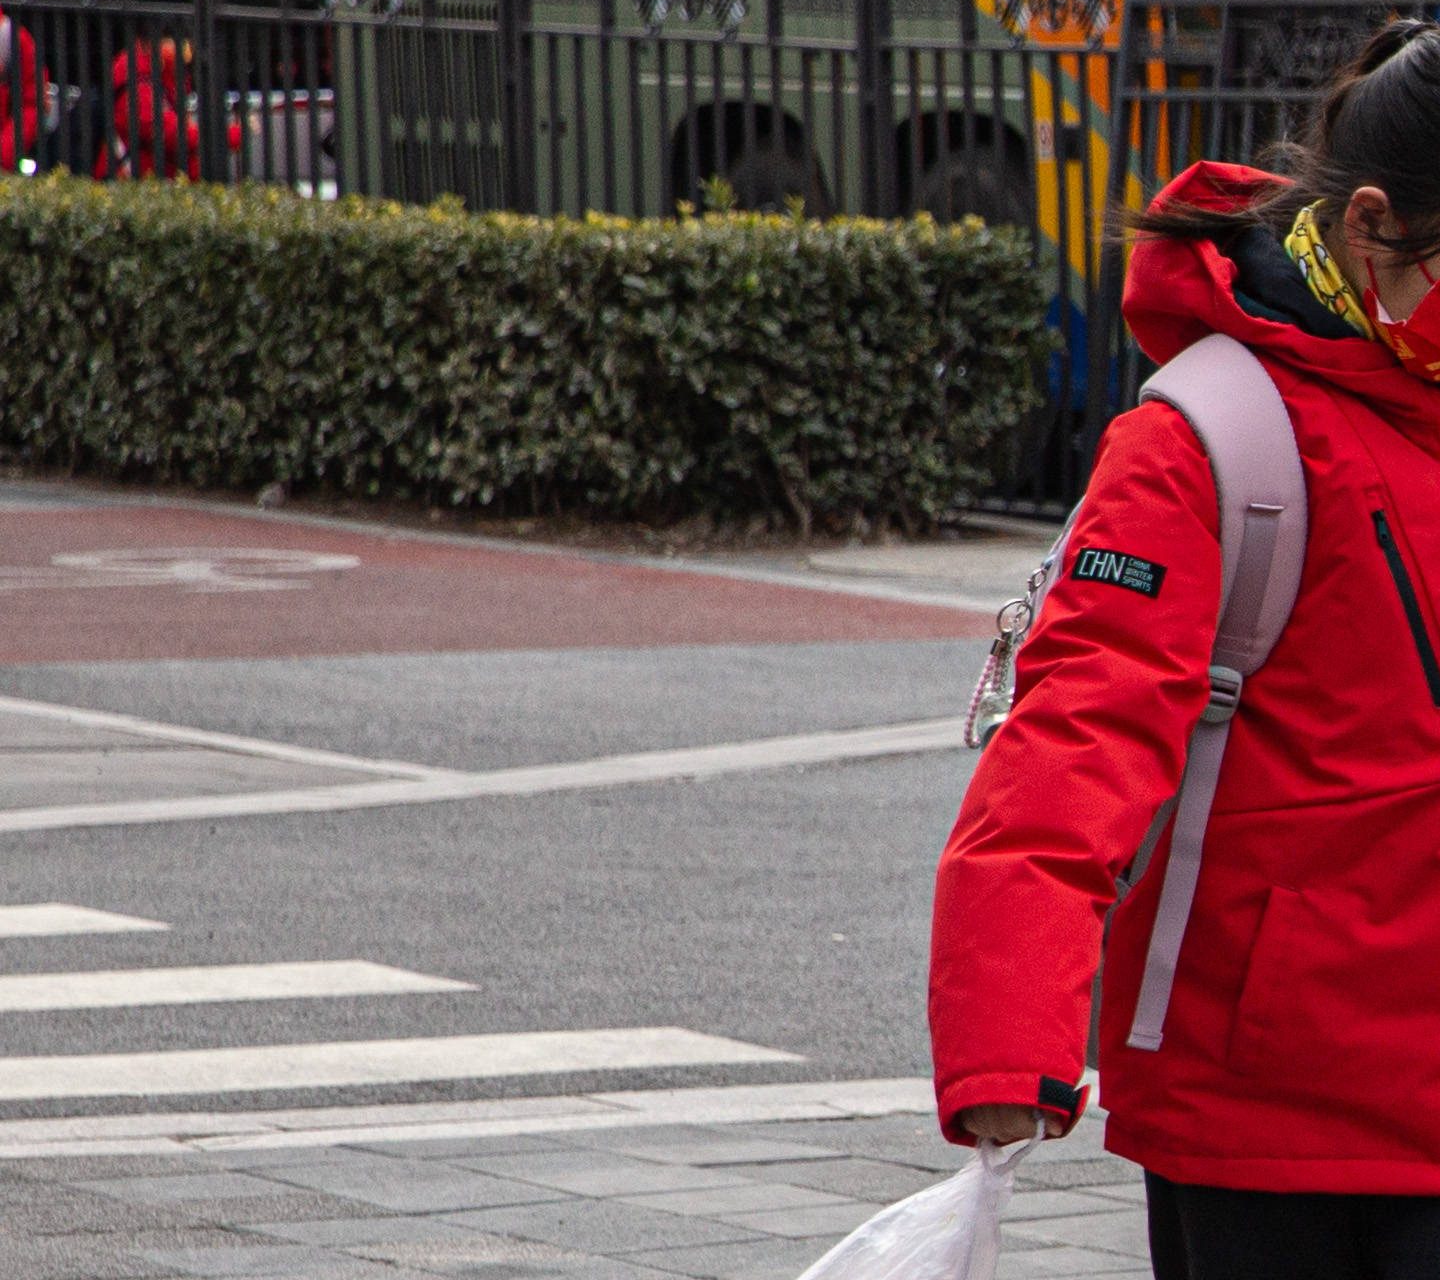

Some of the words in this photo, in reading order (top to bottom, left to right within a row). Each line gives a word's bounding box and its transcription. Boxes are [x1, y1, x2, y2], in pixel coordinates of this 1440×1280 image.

[1078, 551, 1127, 582] CHN
[1127, 558, 1152, 570] CHINA
[1125, 567, 1154, 581] WINTER
[1122, 575, 1152, 592] SPORTS
